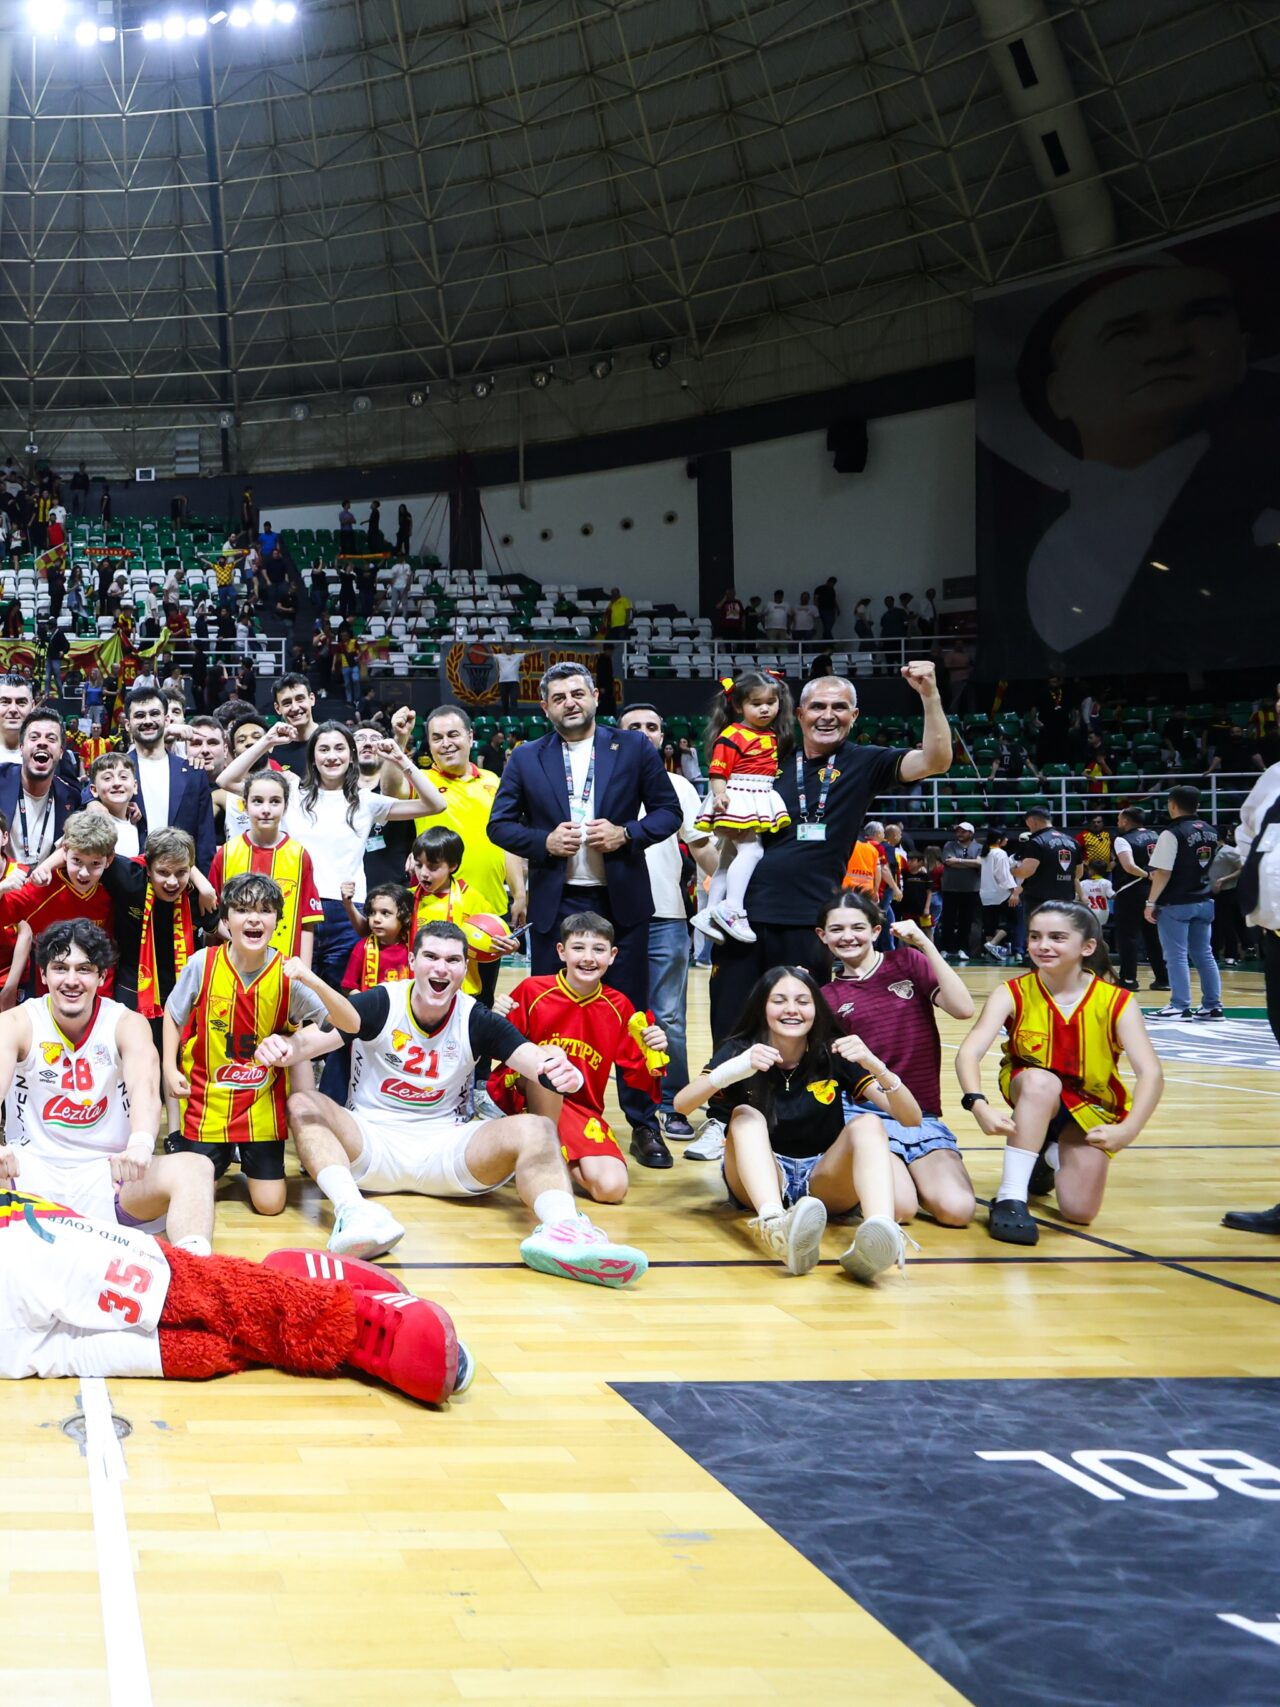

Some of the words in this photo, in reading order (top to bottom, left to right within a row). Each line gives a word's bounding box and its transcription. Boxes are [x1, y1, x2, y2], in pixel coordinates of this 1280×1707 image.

[224, 1032, 258, 1059] 15
[60, 1056, 95, 1092] 28
[221, 1064, 266, 1081] Lezita
[402, 1045, 439, 1079] 21
[386, 1080, 441, 1099] Lezita
[48, 1096, 103, 1121] Lezita
[97, 1256, 154, 1325] 35
